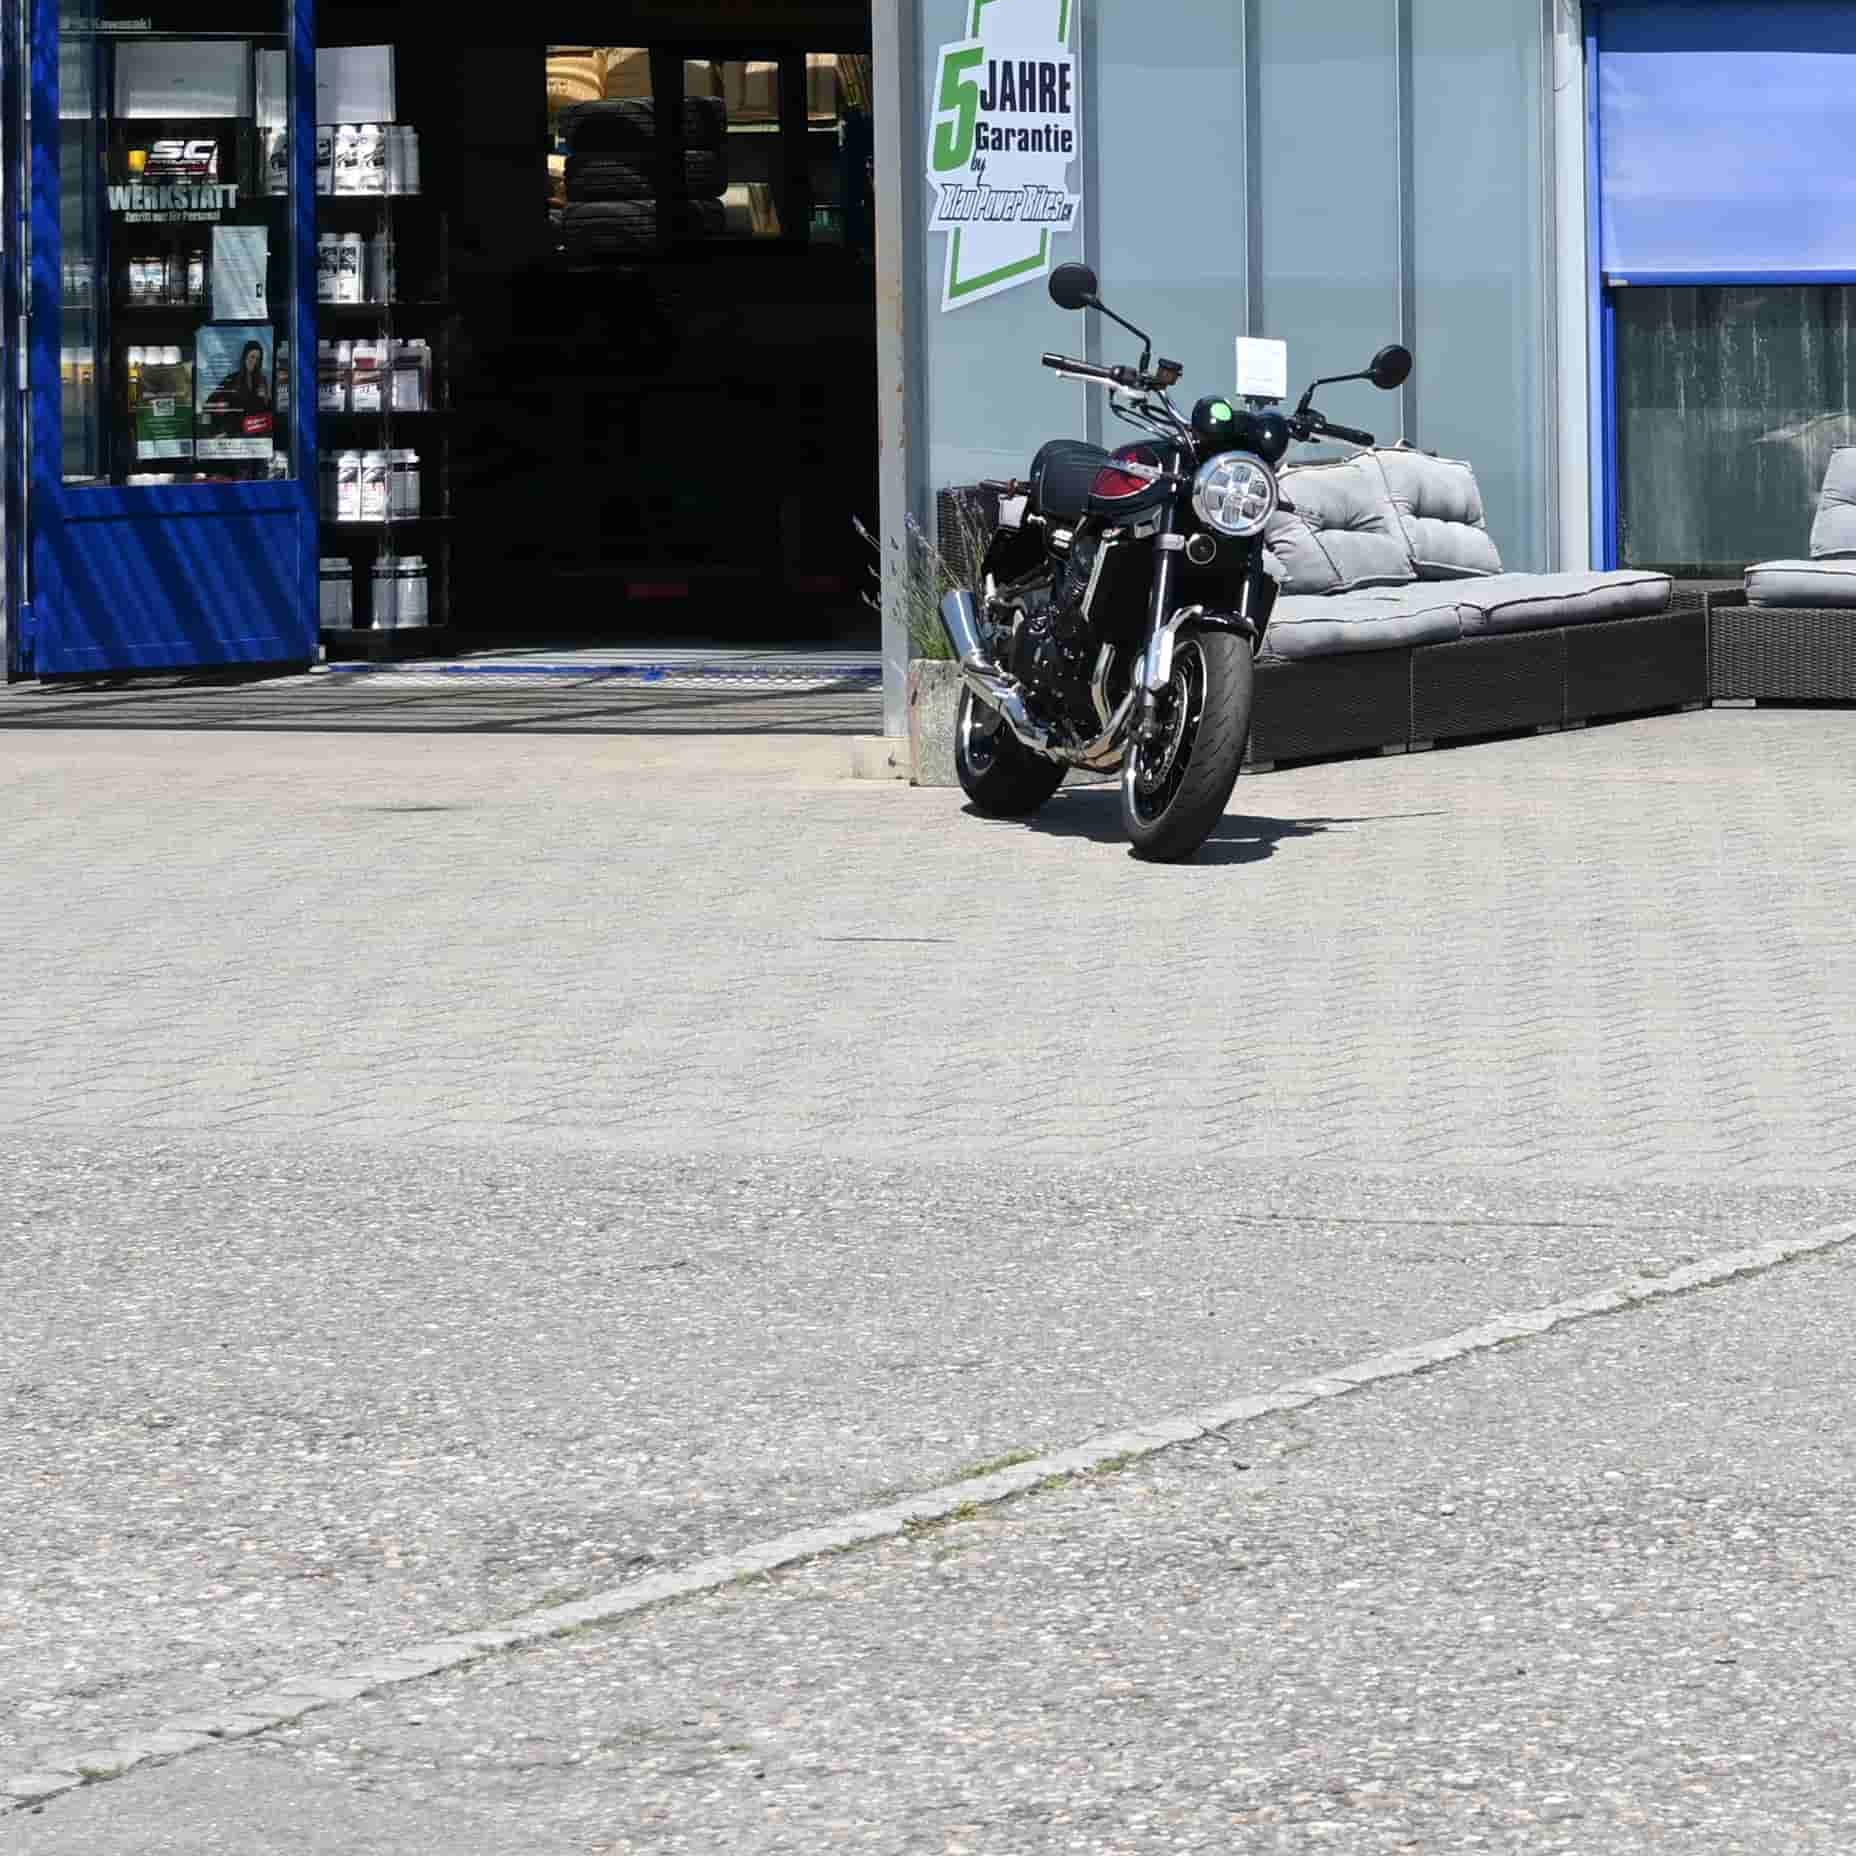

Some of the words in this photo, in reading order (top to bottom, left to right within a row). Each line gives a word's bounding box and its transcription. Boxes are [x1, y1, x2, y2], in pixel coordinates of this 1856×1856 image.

[932, 47, 985, 172] 5
[979, 59, 1072, 114] JAHRE
[150, 140, 217, 160] SC
[975, 121, 1073, 153] Garantie
[970, 157, 986, 185] by
[107, 183, 240, 210] WERKSTATT
